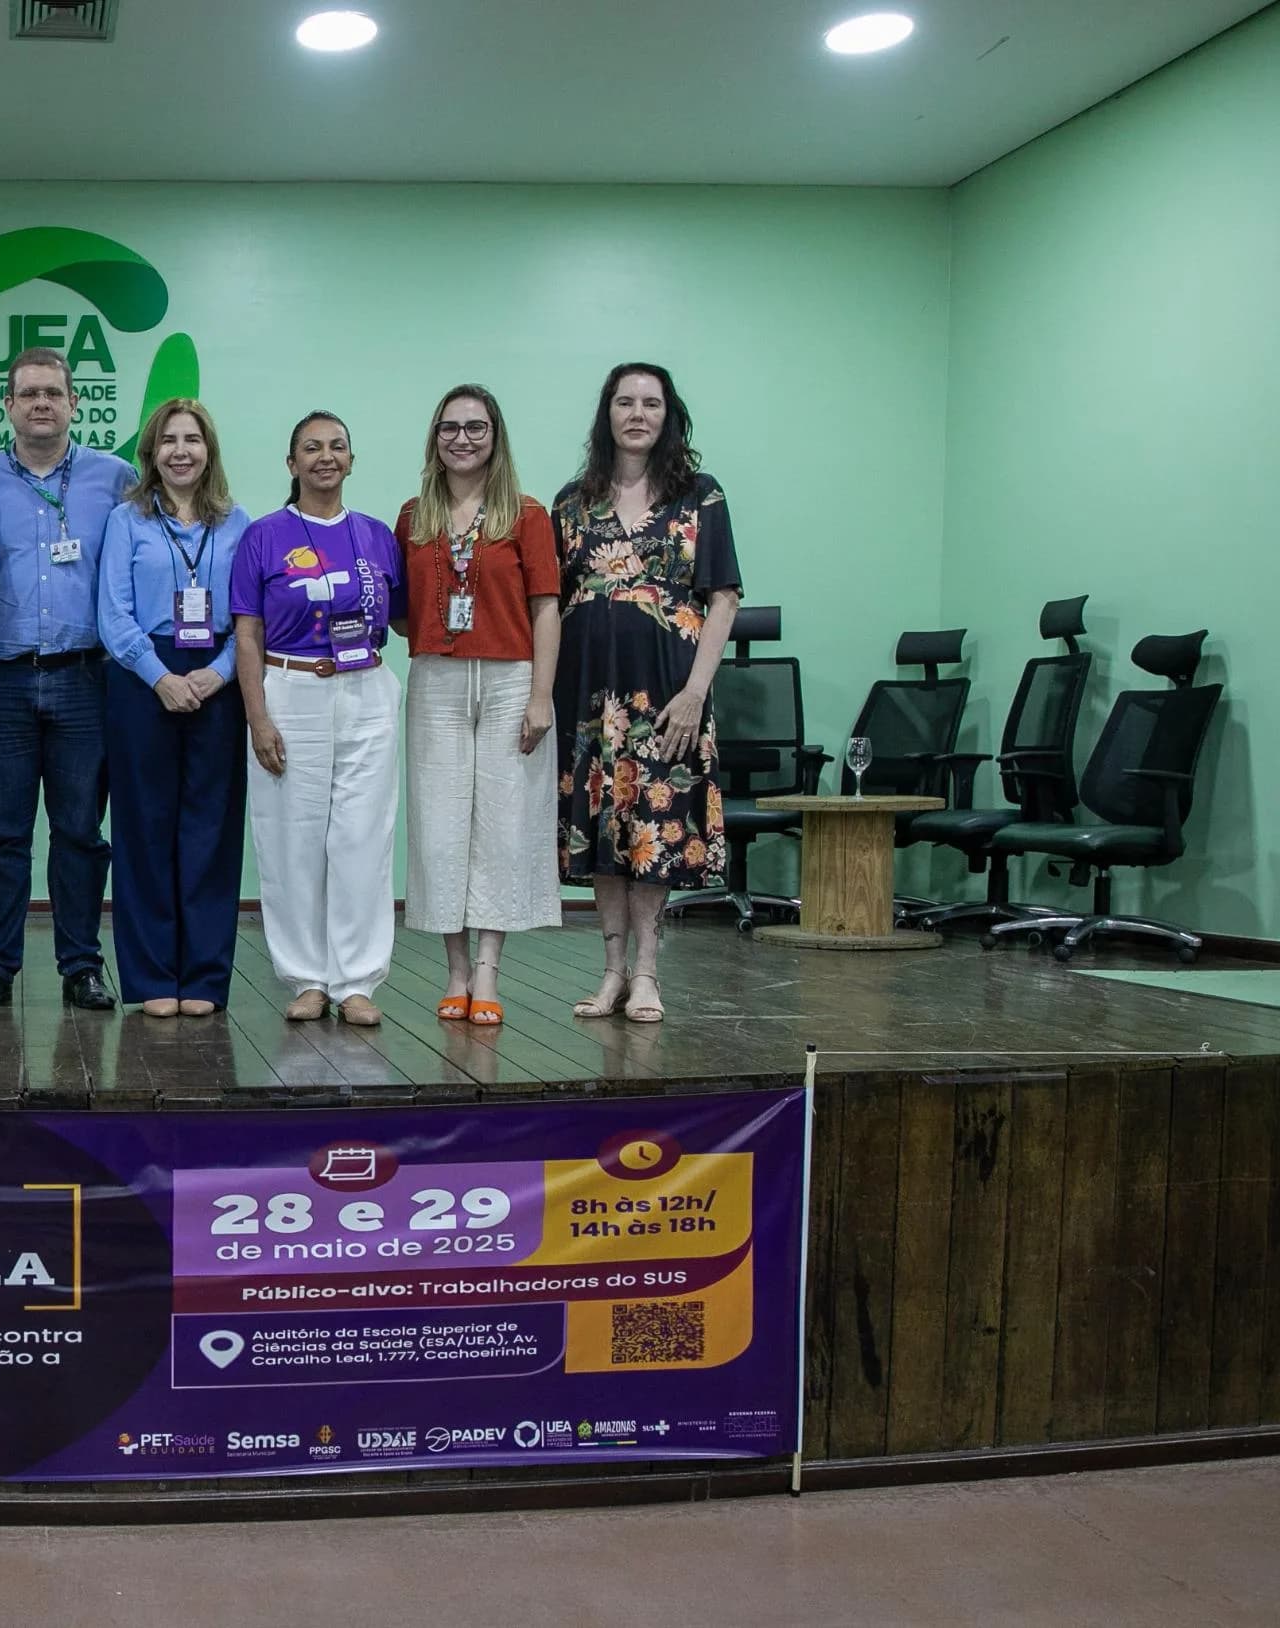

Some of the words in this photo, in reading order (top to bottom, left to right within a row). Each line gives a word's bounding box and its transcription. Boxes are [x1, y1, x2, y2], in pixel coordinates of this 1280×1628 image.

[211, 1193, 313, 1234] 28
[338, 1201, 385, 1232] e
[409, 1187, 511, 1230] 29
[571, 1199, 607, 1214] 8h
[615, 1197, 651, 1213] às
[658, 1190, 717, 1212] 12h/
[570, 1221, 620, 1237] 14h
[628, 1219, 662, 1235] às
[669, 1217, 716, 1232] 18h
[216, 1241, 262, 1260] de
[274, 1238, 367, 1259] maio
[377, 1238, 422, 1257] de
[432, 1233, 515, 1254] 2025
[242, 1283, 413, 1300] Público-alvo:
[419, 1277, 600, 1295] Trabalhadoras
[606, 1273, 637, 1287] do
[643, 1271, 687, 1285] SUS
[252, 1328, 330, 1340] Auditório
[335, 1328, 358, 1338] da
[363, 1326, 417, 1337] Escola
[422, 1323, 492, 1336] Superior
[496, 1322, 518, 1331] de
[252, 1342, 327, 1353] Ciências
[331, 1341, 354, 1351] da
[359, 1339, 414, 1350] Saúde
[419, 1333, 509, 1349] (ESA/UEA),
[513, 1334, 538, 1343] Av.
[42, 1351, 60, 1365] a
[252, 1354, 332, 1366] Carvalho
[336, 1352, 373, 1363] Leal,
[378, 1351, 420, 1362] 1.777,
[424, 1346, 537, 1360] Cachoeirinha
[452, 1428, 507, 1441] PADEV
[546, 1421, 572, 1432] UEA
[594, 1420, 637, 1433] AMAZONAS
[140, 1433, 215, 1447] PET-Saúde
[227, 1432, 300, 1450] Semsa
[140, 1446, 215, 1455] EQUIDADE
[309, 1446, 341, 1454] PPGSC
